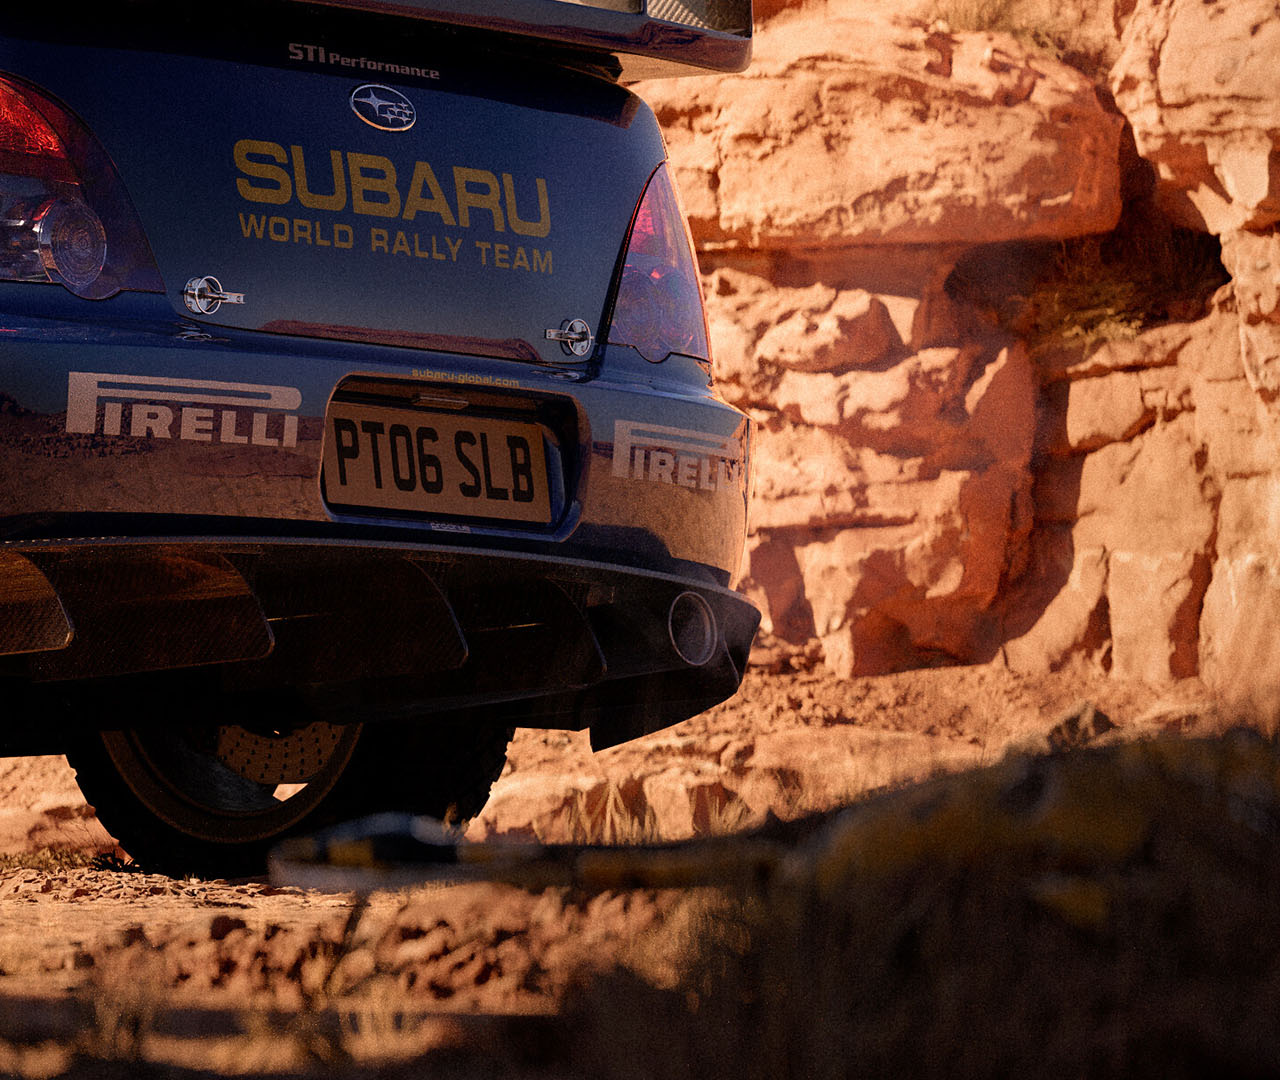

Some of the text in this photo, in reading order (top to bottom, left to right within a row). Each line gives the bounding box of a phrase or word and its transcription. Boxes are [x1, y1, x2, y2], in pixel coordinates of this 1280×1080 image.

[288, 42, 441, 80] STI Performance
[233, 138, 552, 239] SUBARU
[238, 212, 554, 274] WORLD RALLY TEAM
[66, 371, 303, 448] PIRELLI
[333, 417, 535, 503] PT06 SLB
